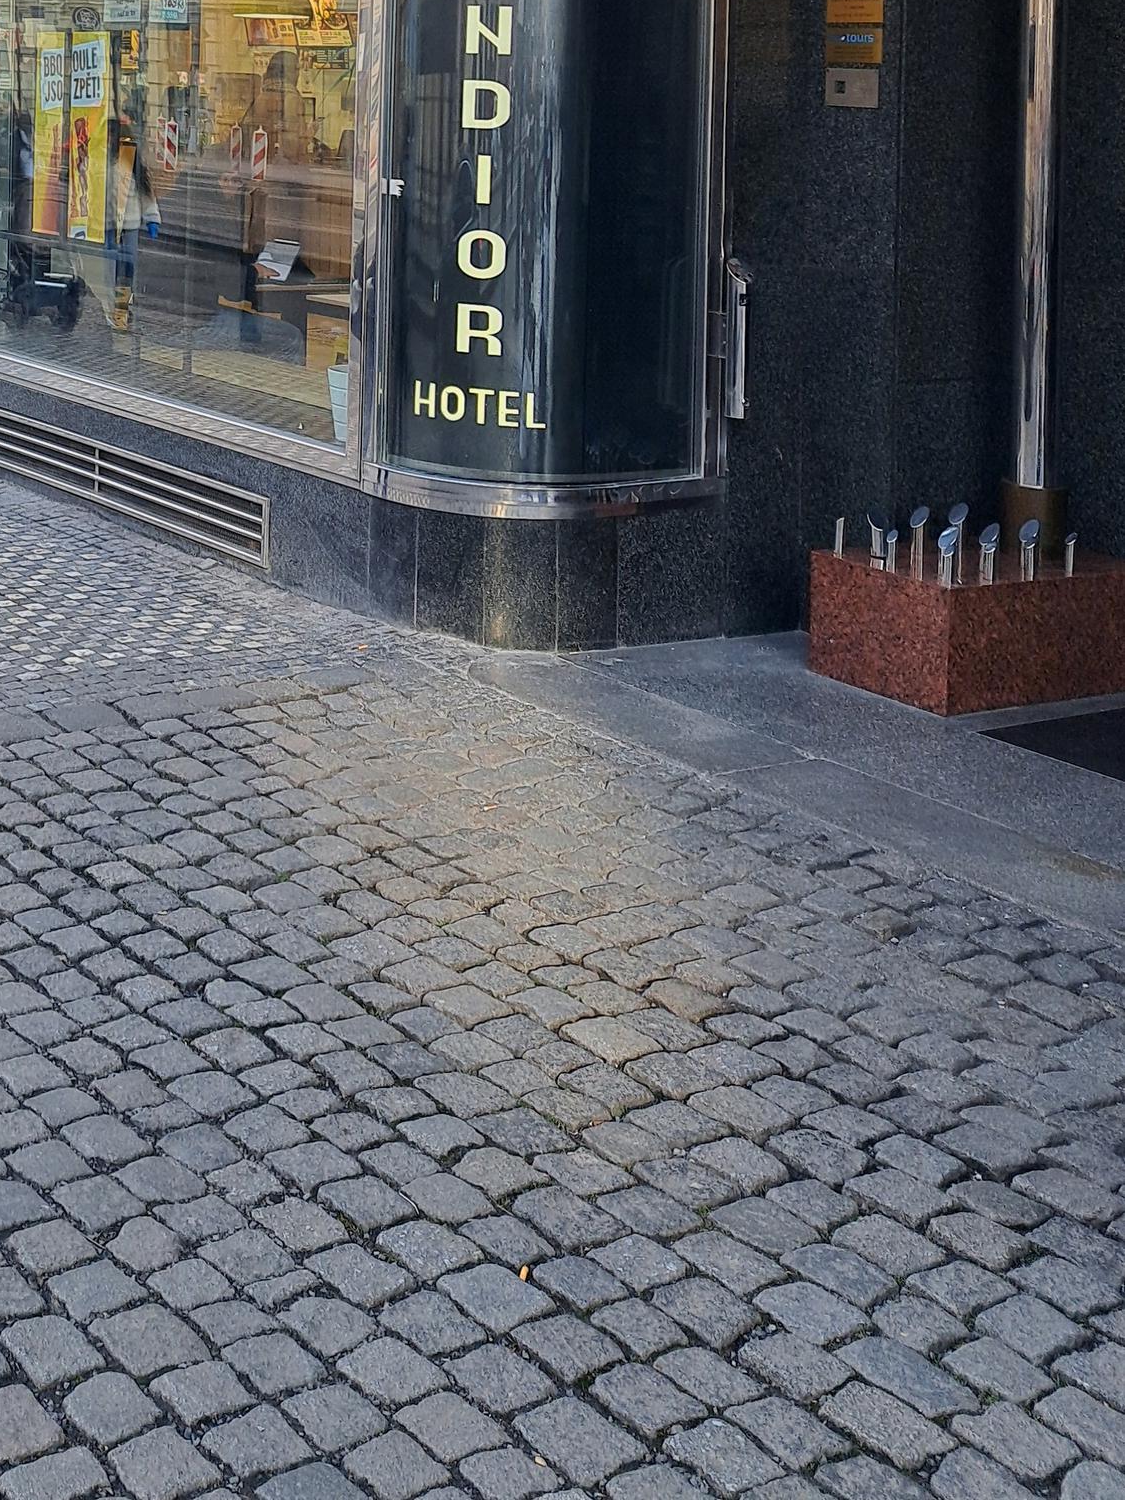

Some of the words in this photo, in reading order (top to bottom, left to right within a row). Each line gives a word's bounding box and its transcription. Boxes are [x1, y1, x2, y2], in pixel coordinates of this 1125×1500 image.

[43, 53, 63, 77] BBQ
[71, 47, 98, 73] OULE
[73, 72, 100, 100] ZPĚT!
[414, 379, 547, 430] HOTEL
